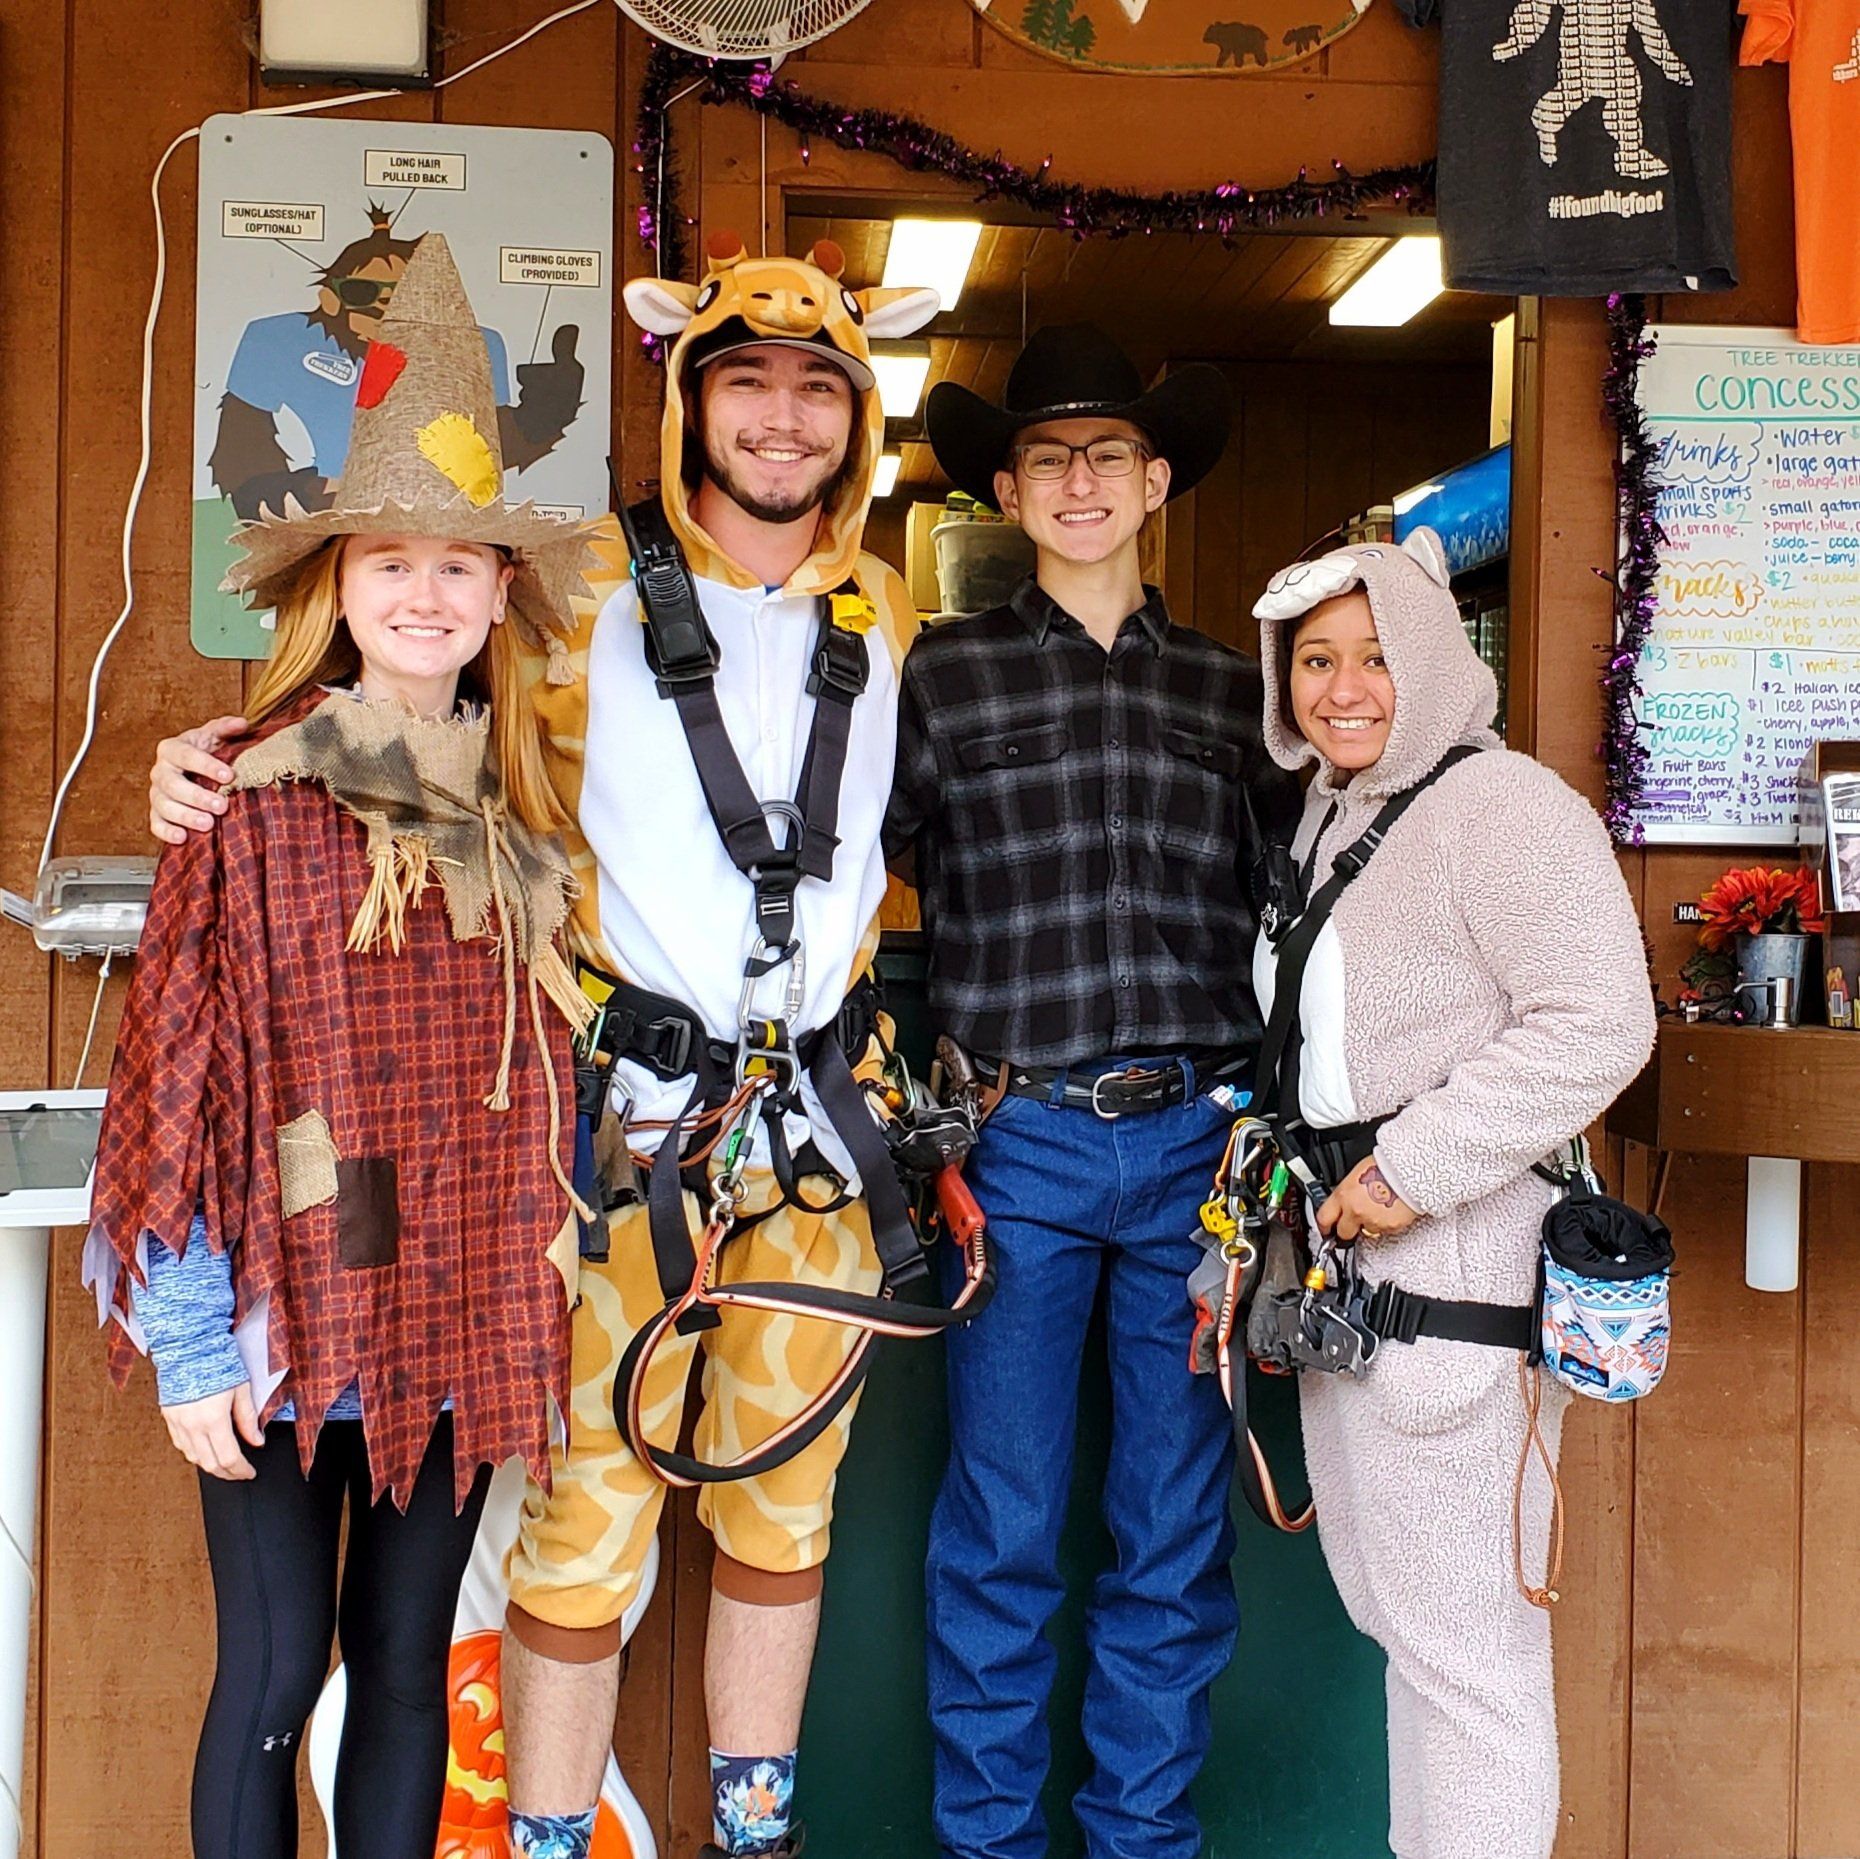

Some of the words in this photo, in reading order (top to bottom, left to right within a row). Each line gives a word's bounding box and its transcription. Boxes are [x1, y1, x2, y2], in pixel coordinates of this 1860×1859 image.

[390, 157, 416, 168] LONG
[418, 159, 441, 169] HAIR
[382, 171, 420, 183] PULLED
[422, 173, 449, 184] BACK
[1548, 190, 1664, 219] #ifoundbigfoot
[231, 207, 317, 220] SUNGLASSES/HAT
[245, 222, 302, 235] (OPTIONAL)
[508, 253, 554, 265] CLIMBING
[556, 255, 593, 267] GLOVES
[521, 268, 579, 281] (PROVIDED)
[1727, 350, 1779, 367] TREE
[1658, 430, 1742, 471] drinks
[1775, 453, 1818, 478] large
[1796, 475, 1839, 491] orange,
[1652, 502, 1718, 521] drinks
[1769, 499, 1813, 516] small
[1772, 519, 1818, 534] purple,
[1769, 552, 1809, 567] juice
[1764, 570, 1798, 591] $2
[1783, 631, 1814, 647] bar
[1768, 652, 1793, 676] $1
[1643, 700, 1726, 720] FROZEN
[1811, 697, 1847, 714] push
[1810, 715, 1850, 732] apple,
[1697, 760, 1727, 773] Bars
[1642, 776, 1697, 791] angerine,
